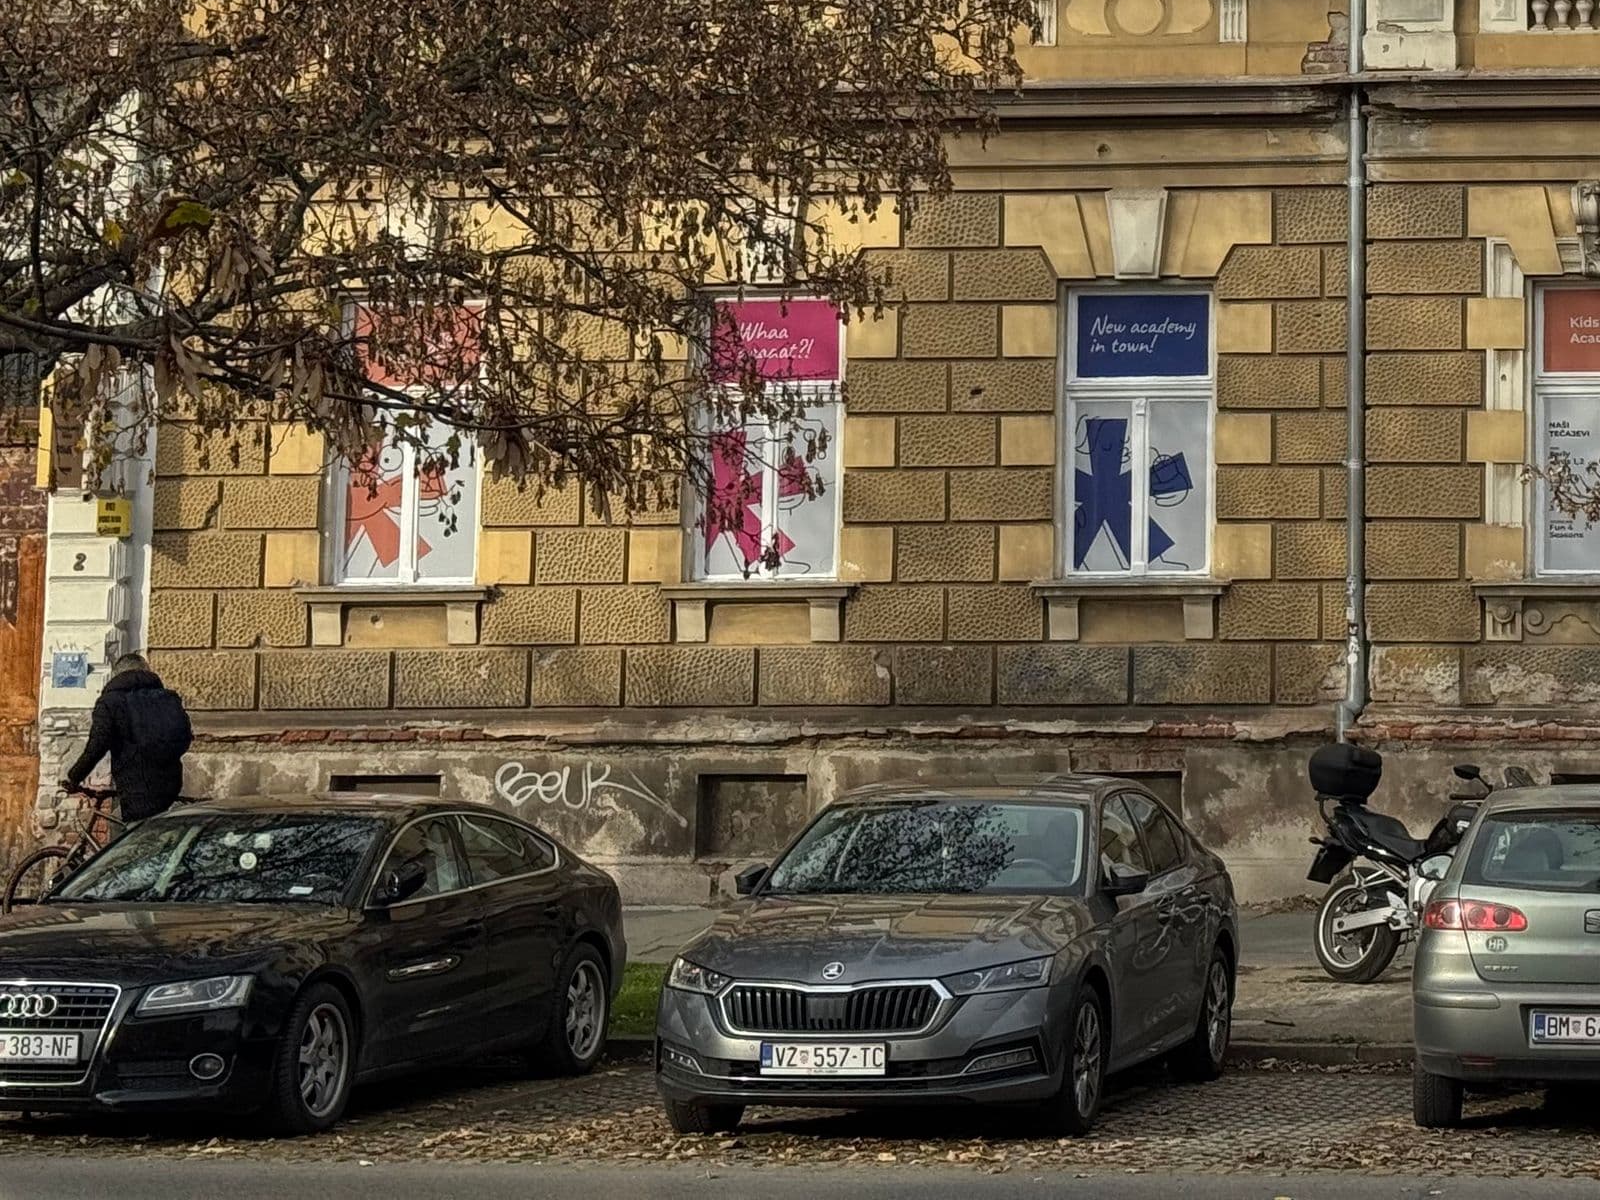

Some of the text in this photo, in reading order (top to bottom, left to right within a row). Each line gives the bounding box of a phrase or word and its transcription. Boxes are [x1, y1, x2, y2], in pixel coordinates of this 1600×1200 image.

[740, 321, 789, 342] Whaa
[1090, 314, 1197, 340] New academy
[1570, 316, 1600, 328] Kids
[1090, 333, 1158, 353] in town!
[73, 552, 87, 571] 2
[1547, 1017, 1570, 1037] BM
[9, 1035, 75, 1057] 383-NF
[813, 1047, 883, 1068] 557-TC
